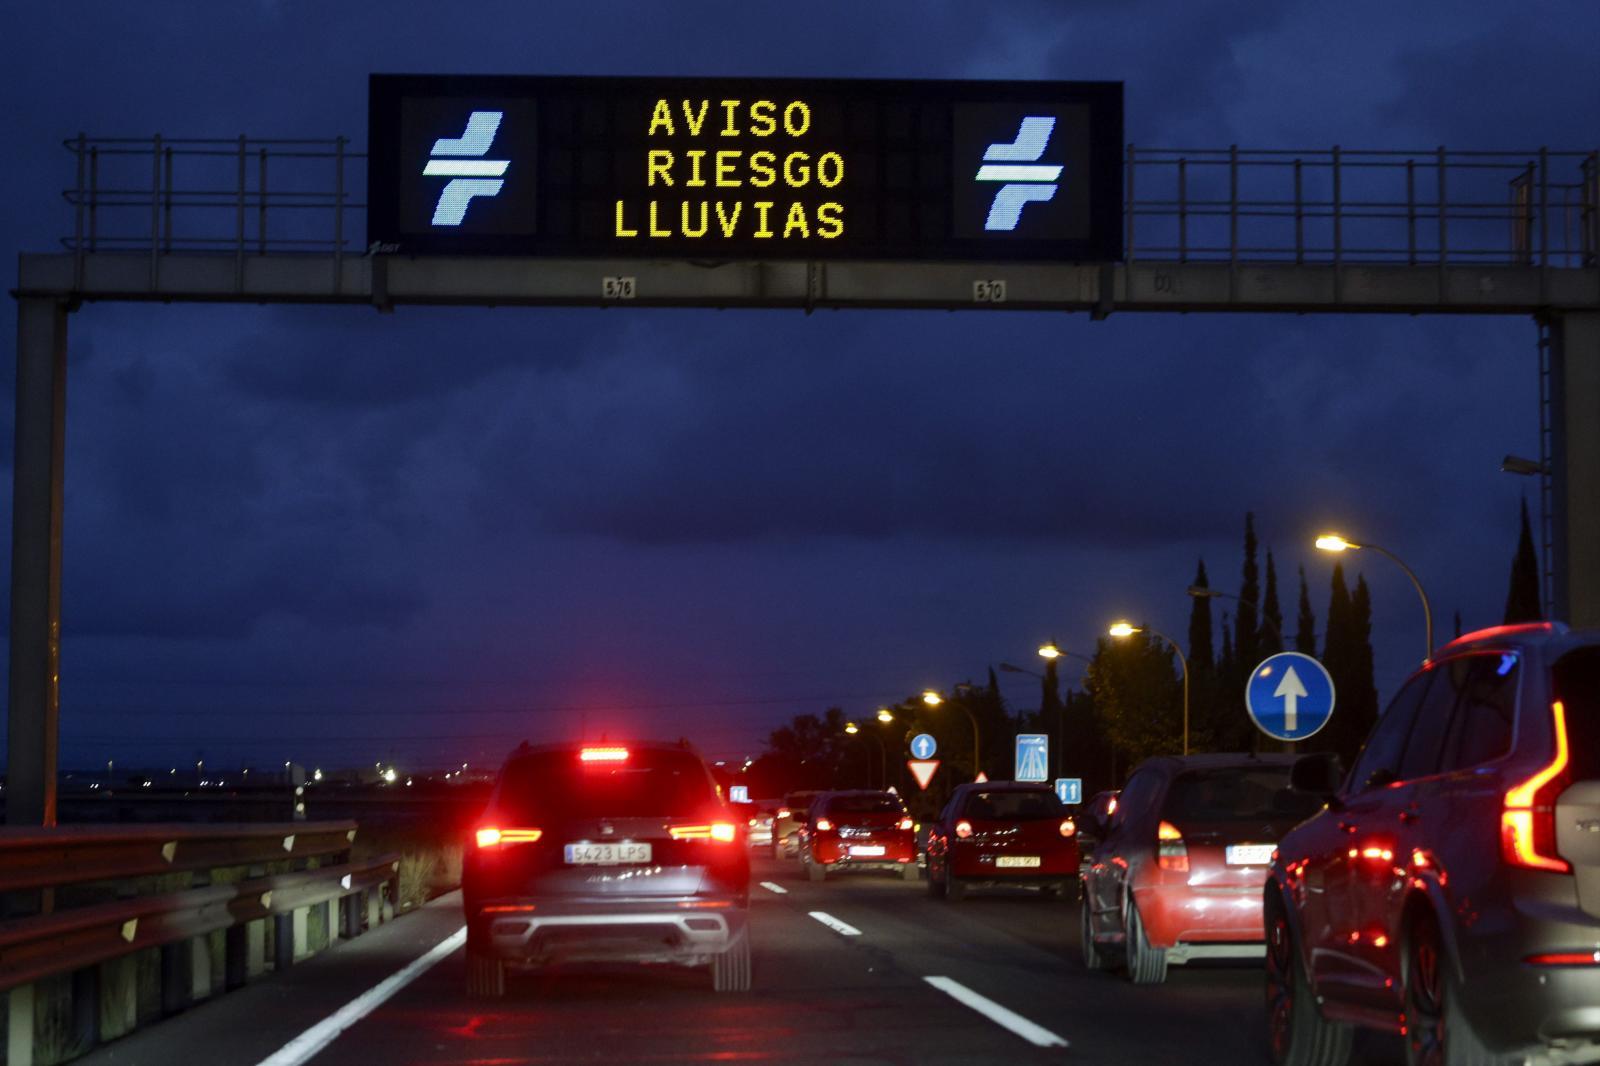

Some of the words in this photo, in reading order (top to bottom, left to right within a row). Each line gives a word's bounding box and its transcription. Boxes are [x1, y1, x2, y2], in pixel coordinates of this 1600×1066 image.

[649, 100, 810, 136] AVISO
[648, 150, 843, 188] RIESGO
[615, 201, 843, 238] LLUVIAS
